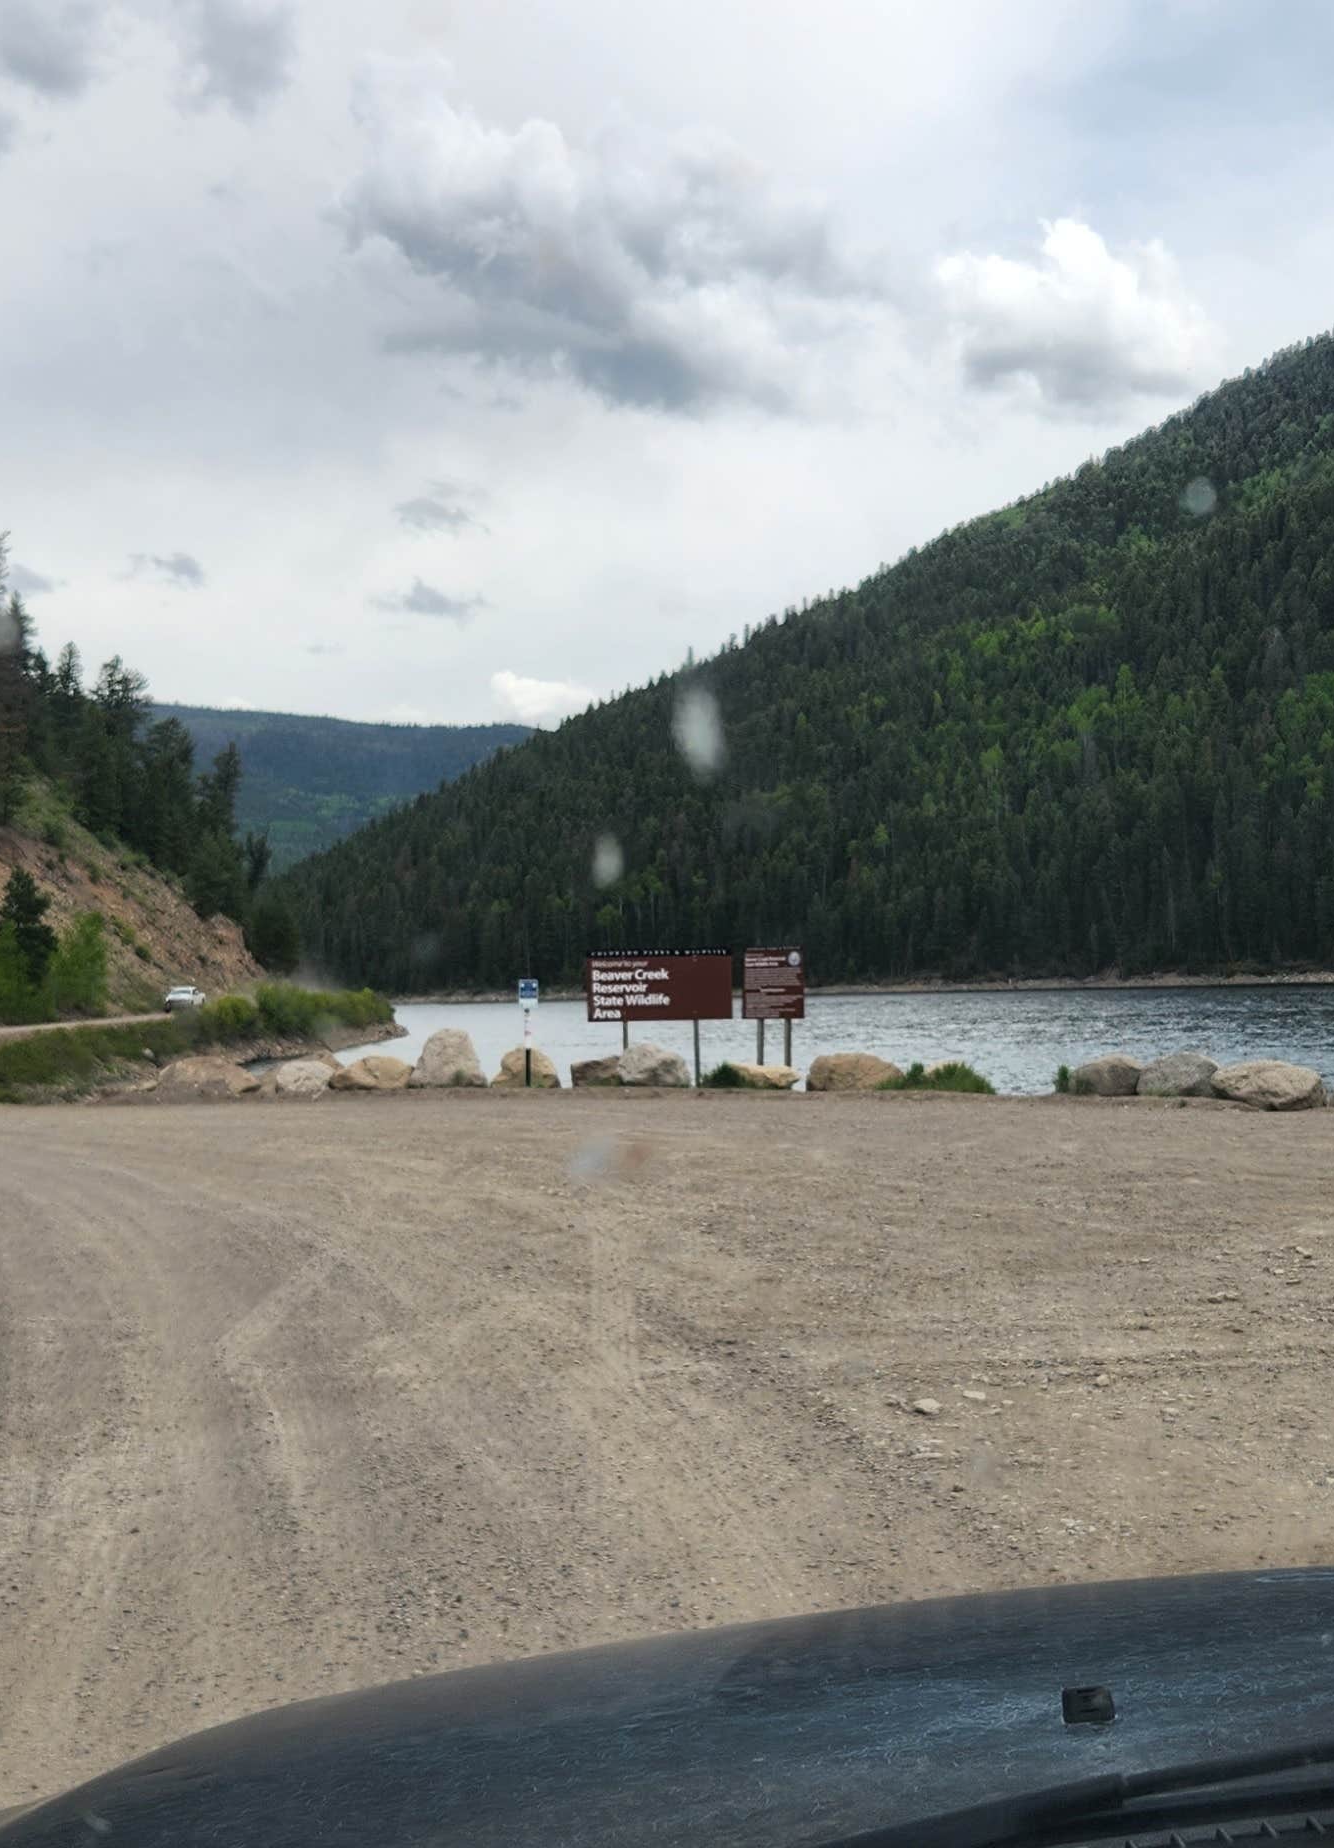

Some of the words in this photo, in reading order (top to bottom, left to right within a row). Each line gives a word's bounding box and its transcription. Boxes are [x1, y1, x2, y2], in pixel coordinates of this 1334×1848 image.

[592, 960, 623, 968] Welcome
[632, 961, 648, 969] your
[592, 969, 633, 981] Beaver
[634, 968, 669, 980] Creek
[593, 981, 648, 993] Reservoir
[593, 995, 624, 1006] State
[625, 993, 670, 1006] Wildlife
[593, 1007, 621, 1019] Area
